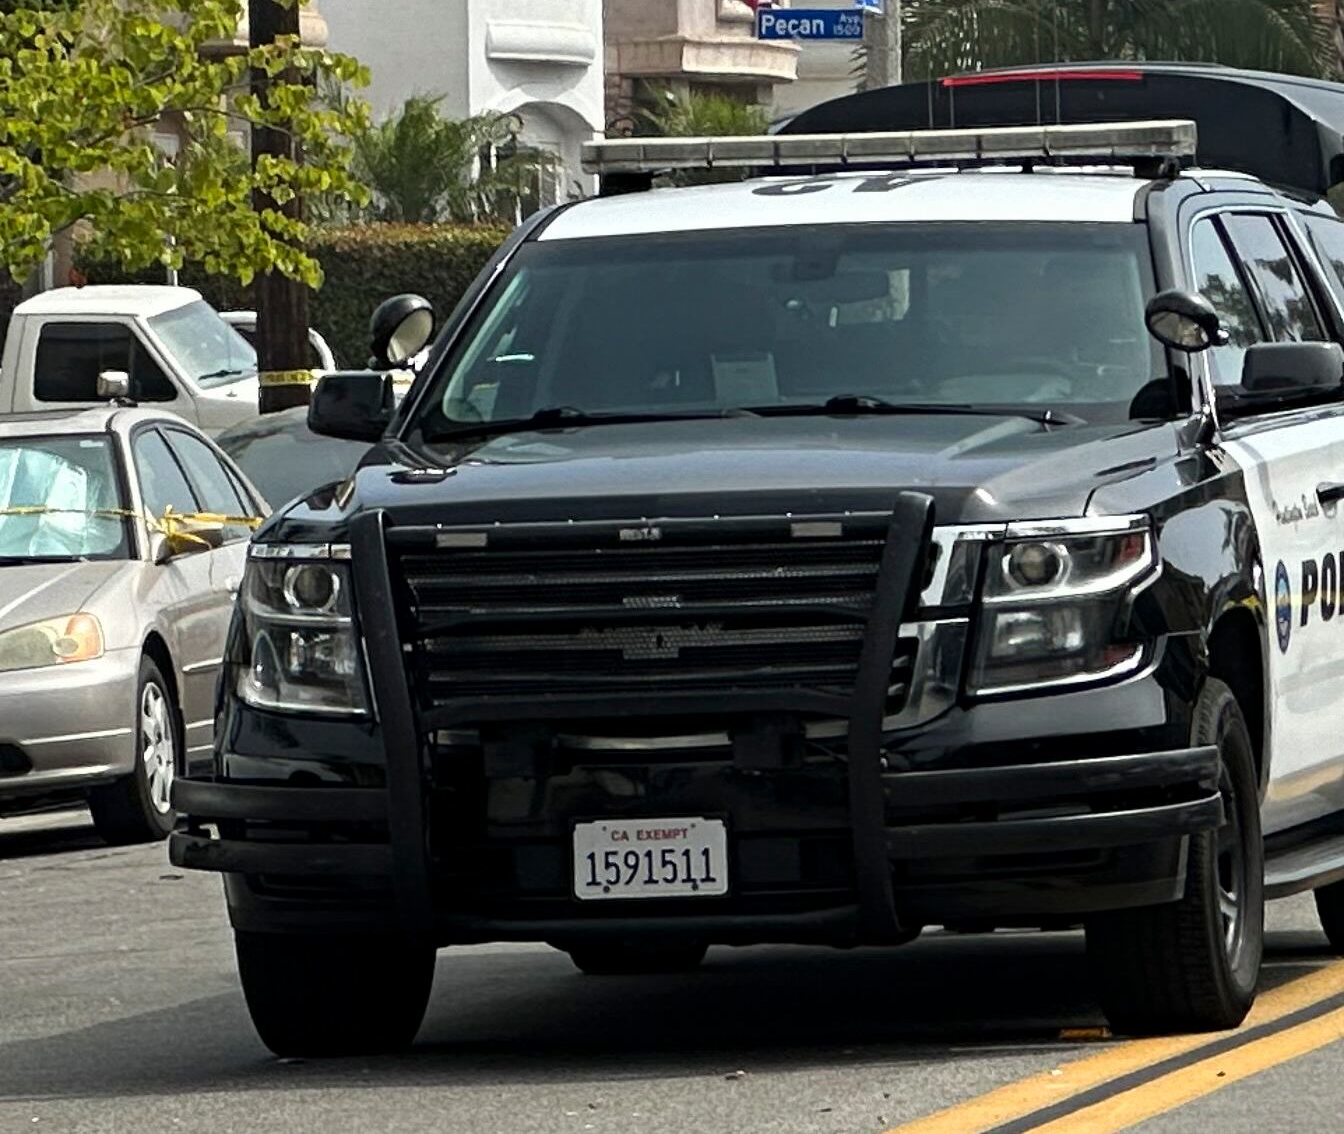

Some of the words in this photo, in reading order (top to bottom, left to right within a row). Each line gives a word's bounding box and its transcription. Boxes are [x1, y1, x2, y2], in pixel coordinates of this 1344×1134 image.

[761, 14, 825, 35] Pecan
[611, 830, 630, 842] CA
[636, 828, 688, 841] EXEMPT
[586, 847, 716, 886] 1591511
